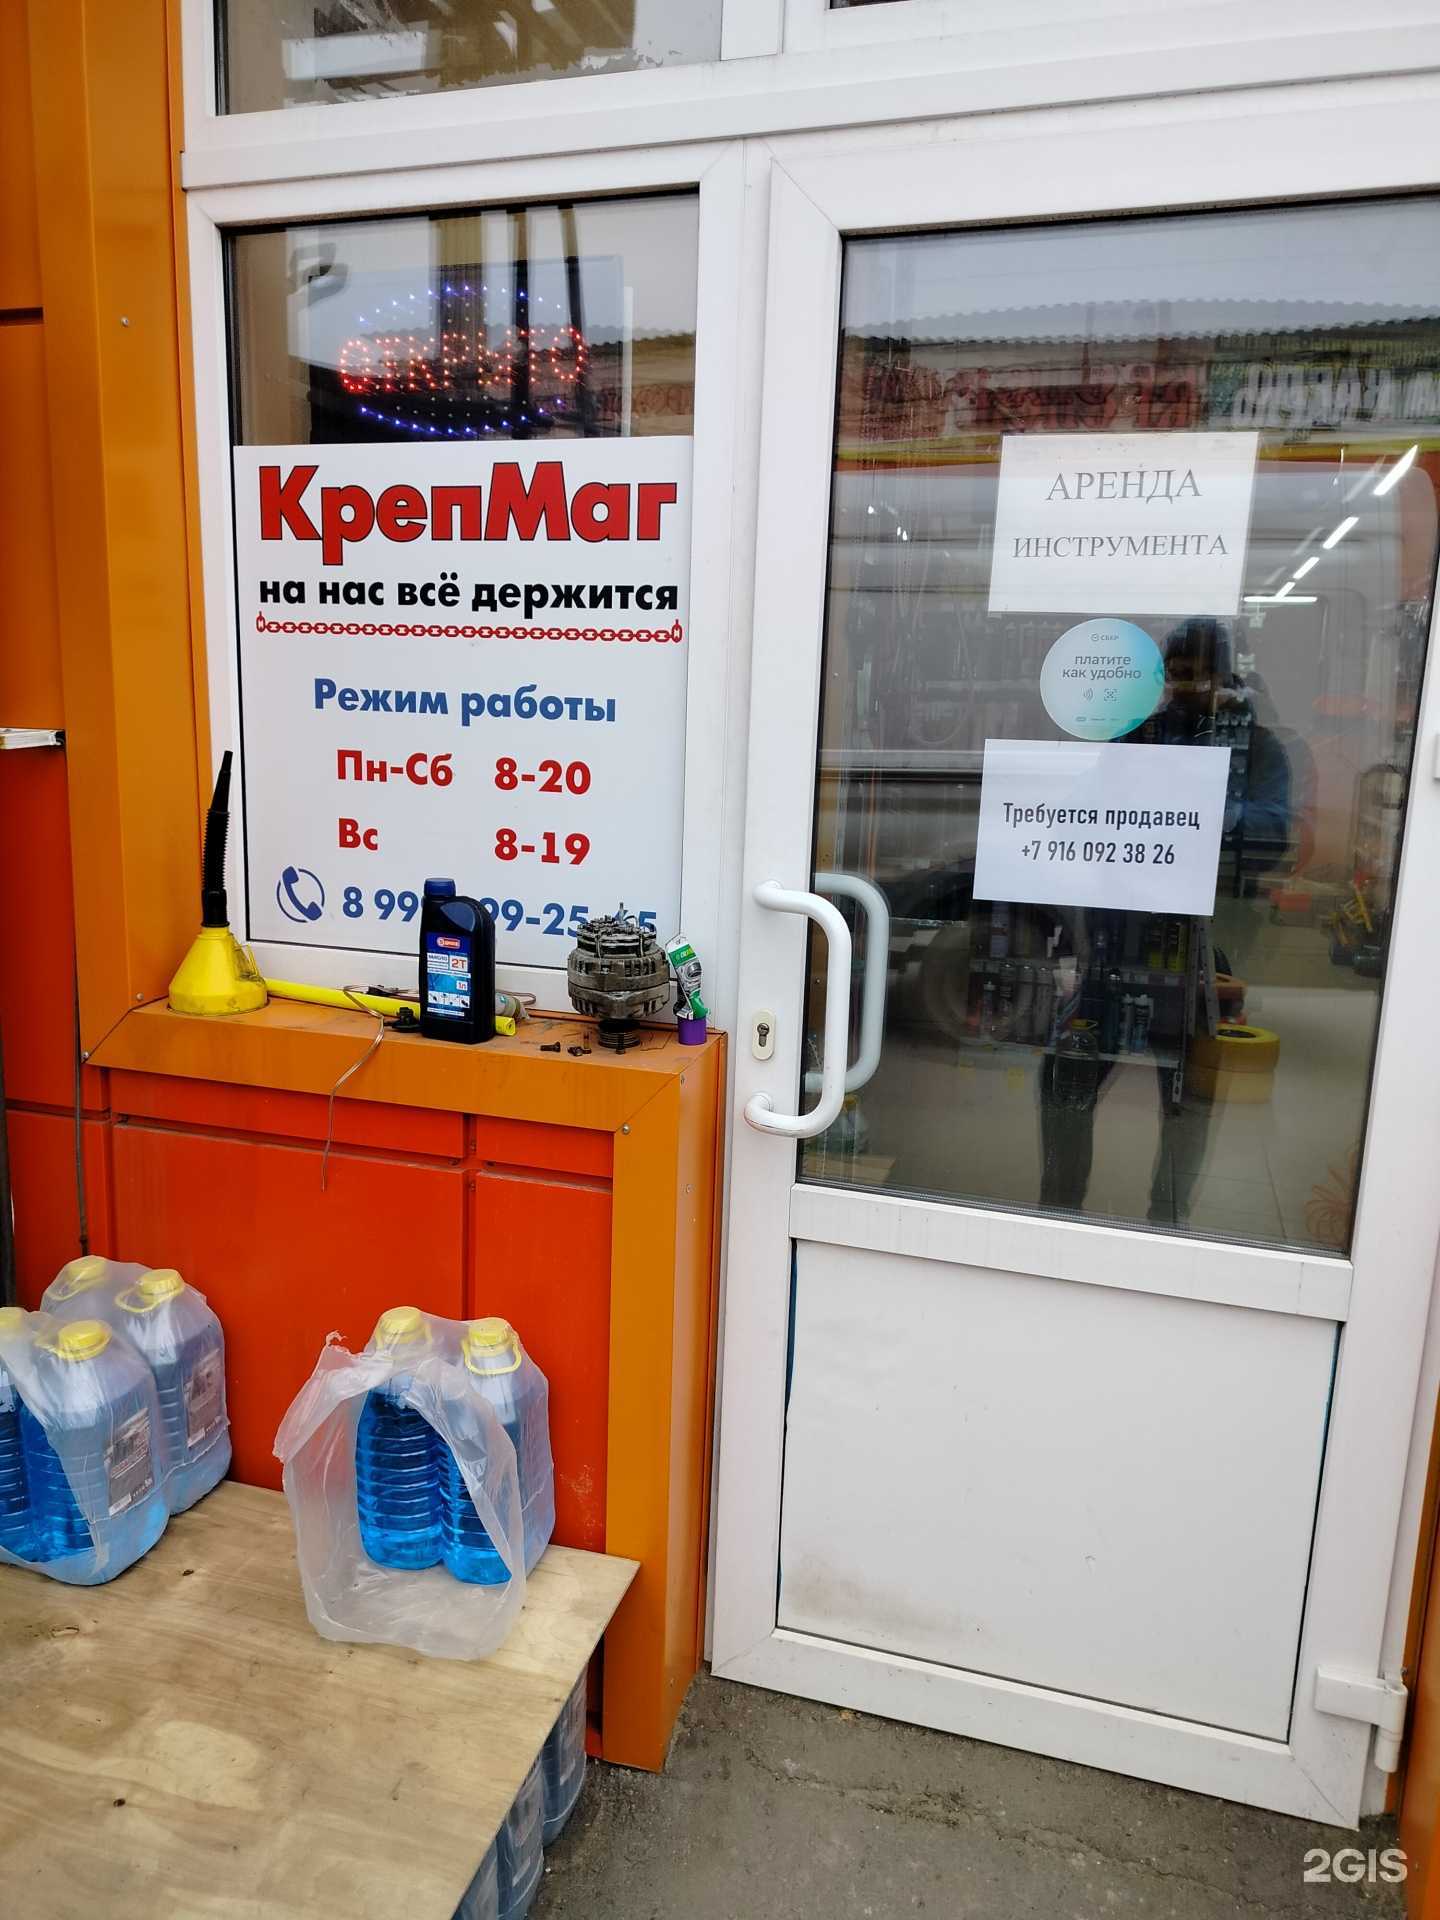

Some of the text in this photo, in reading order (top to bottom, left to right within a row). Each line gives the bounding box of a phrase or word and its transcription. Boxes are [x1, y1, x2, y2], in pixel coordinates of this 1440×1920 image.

[1045, 469, 1203, 505] АРЕНДА
[258, 461, 678, 566] КрепМаг
[1012, 534, 1229, 558] ИНСТРУМЕНТА
[259, 571, 679, 619] на нас всё держится
[1062, 667, 1142, 681] как удобно
[1074, 655, 1132, 666] платите
[314, 677, 617, 727] Режим работы
[336, 749, 592, 796] Пн-Сб 8-20
[1003, 802, 1201, 831] Требуется продавец
[338, 817, 591, 866] Вс 8-19
[1021, 840, 1175, 865] +7 916 092 38 26
[342, 886, 364, 919] 8
[374, 888, 425, 923] 99
